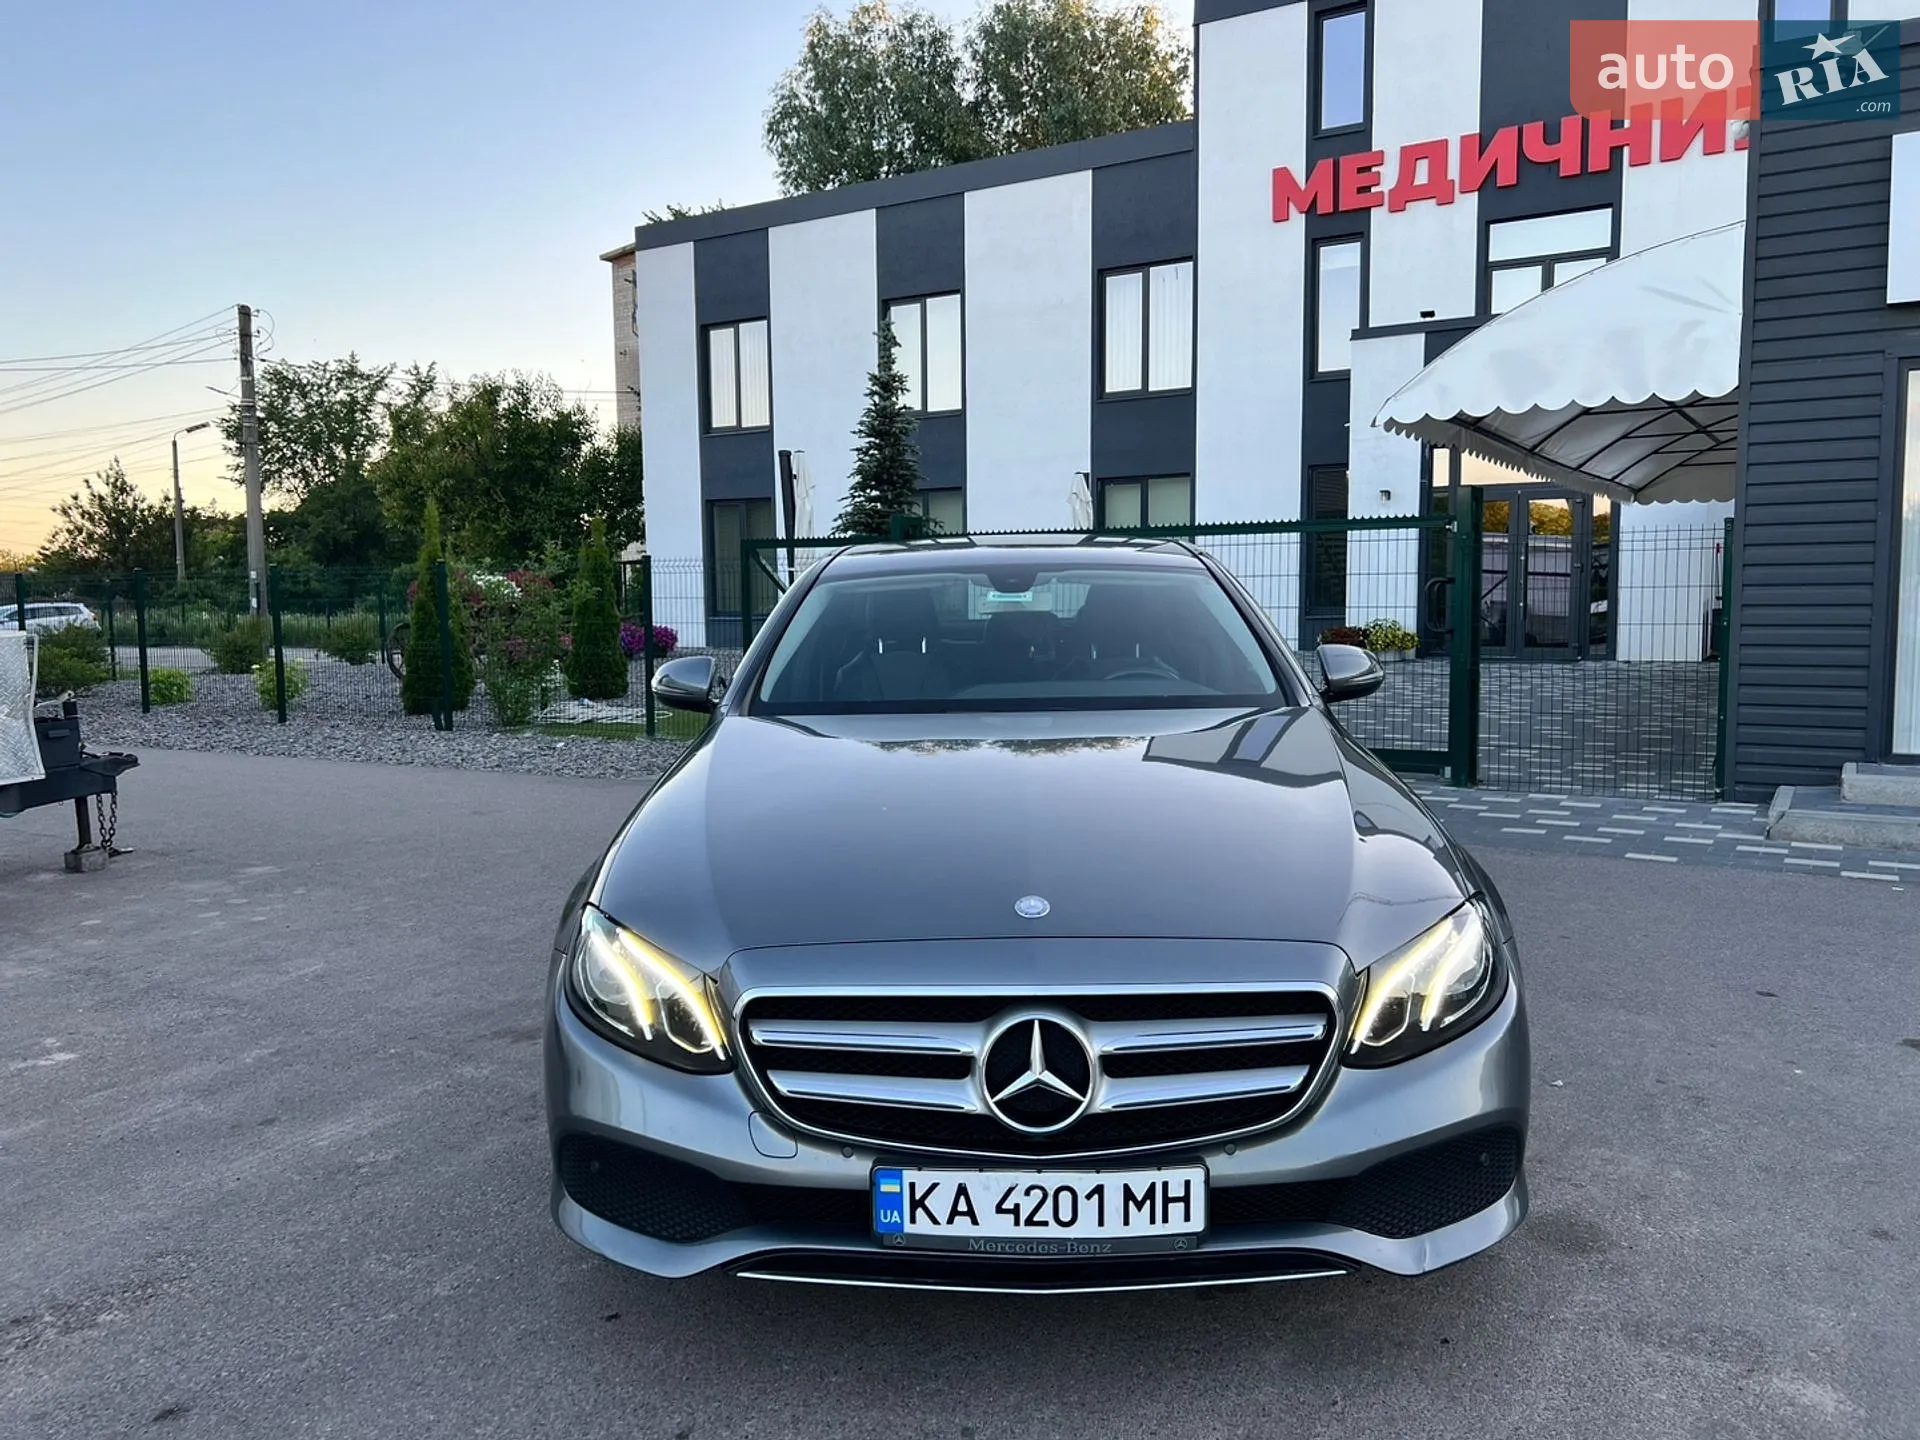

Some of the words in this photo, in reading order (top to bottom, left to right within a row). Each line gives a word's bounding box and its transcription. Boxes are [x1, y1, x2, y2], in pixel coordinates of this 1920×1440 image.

[1271, 85, 1751, 223] МЕДИЧНИ
[880, 1210, 901, 1223] UA
[908, 1181, 980, 1228] KA
[994, 1182, 1106, 1229] 4201
[967, 1237, 1113, 1255] Mercedes-Benz
